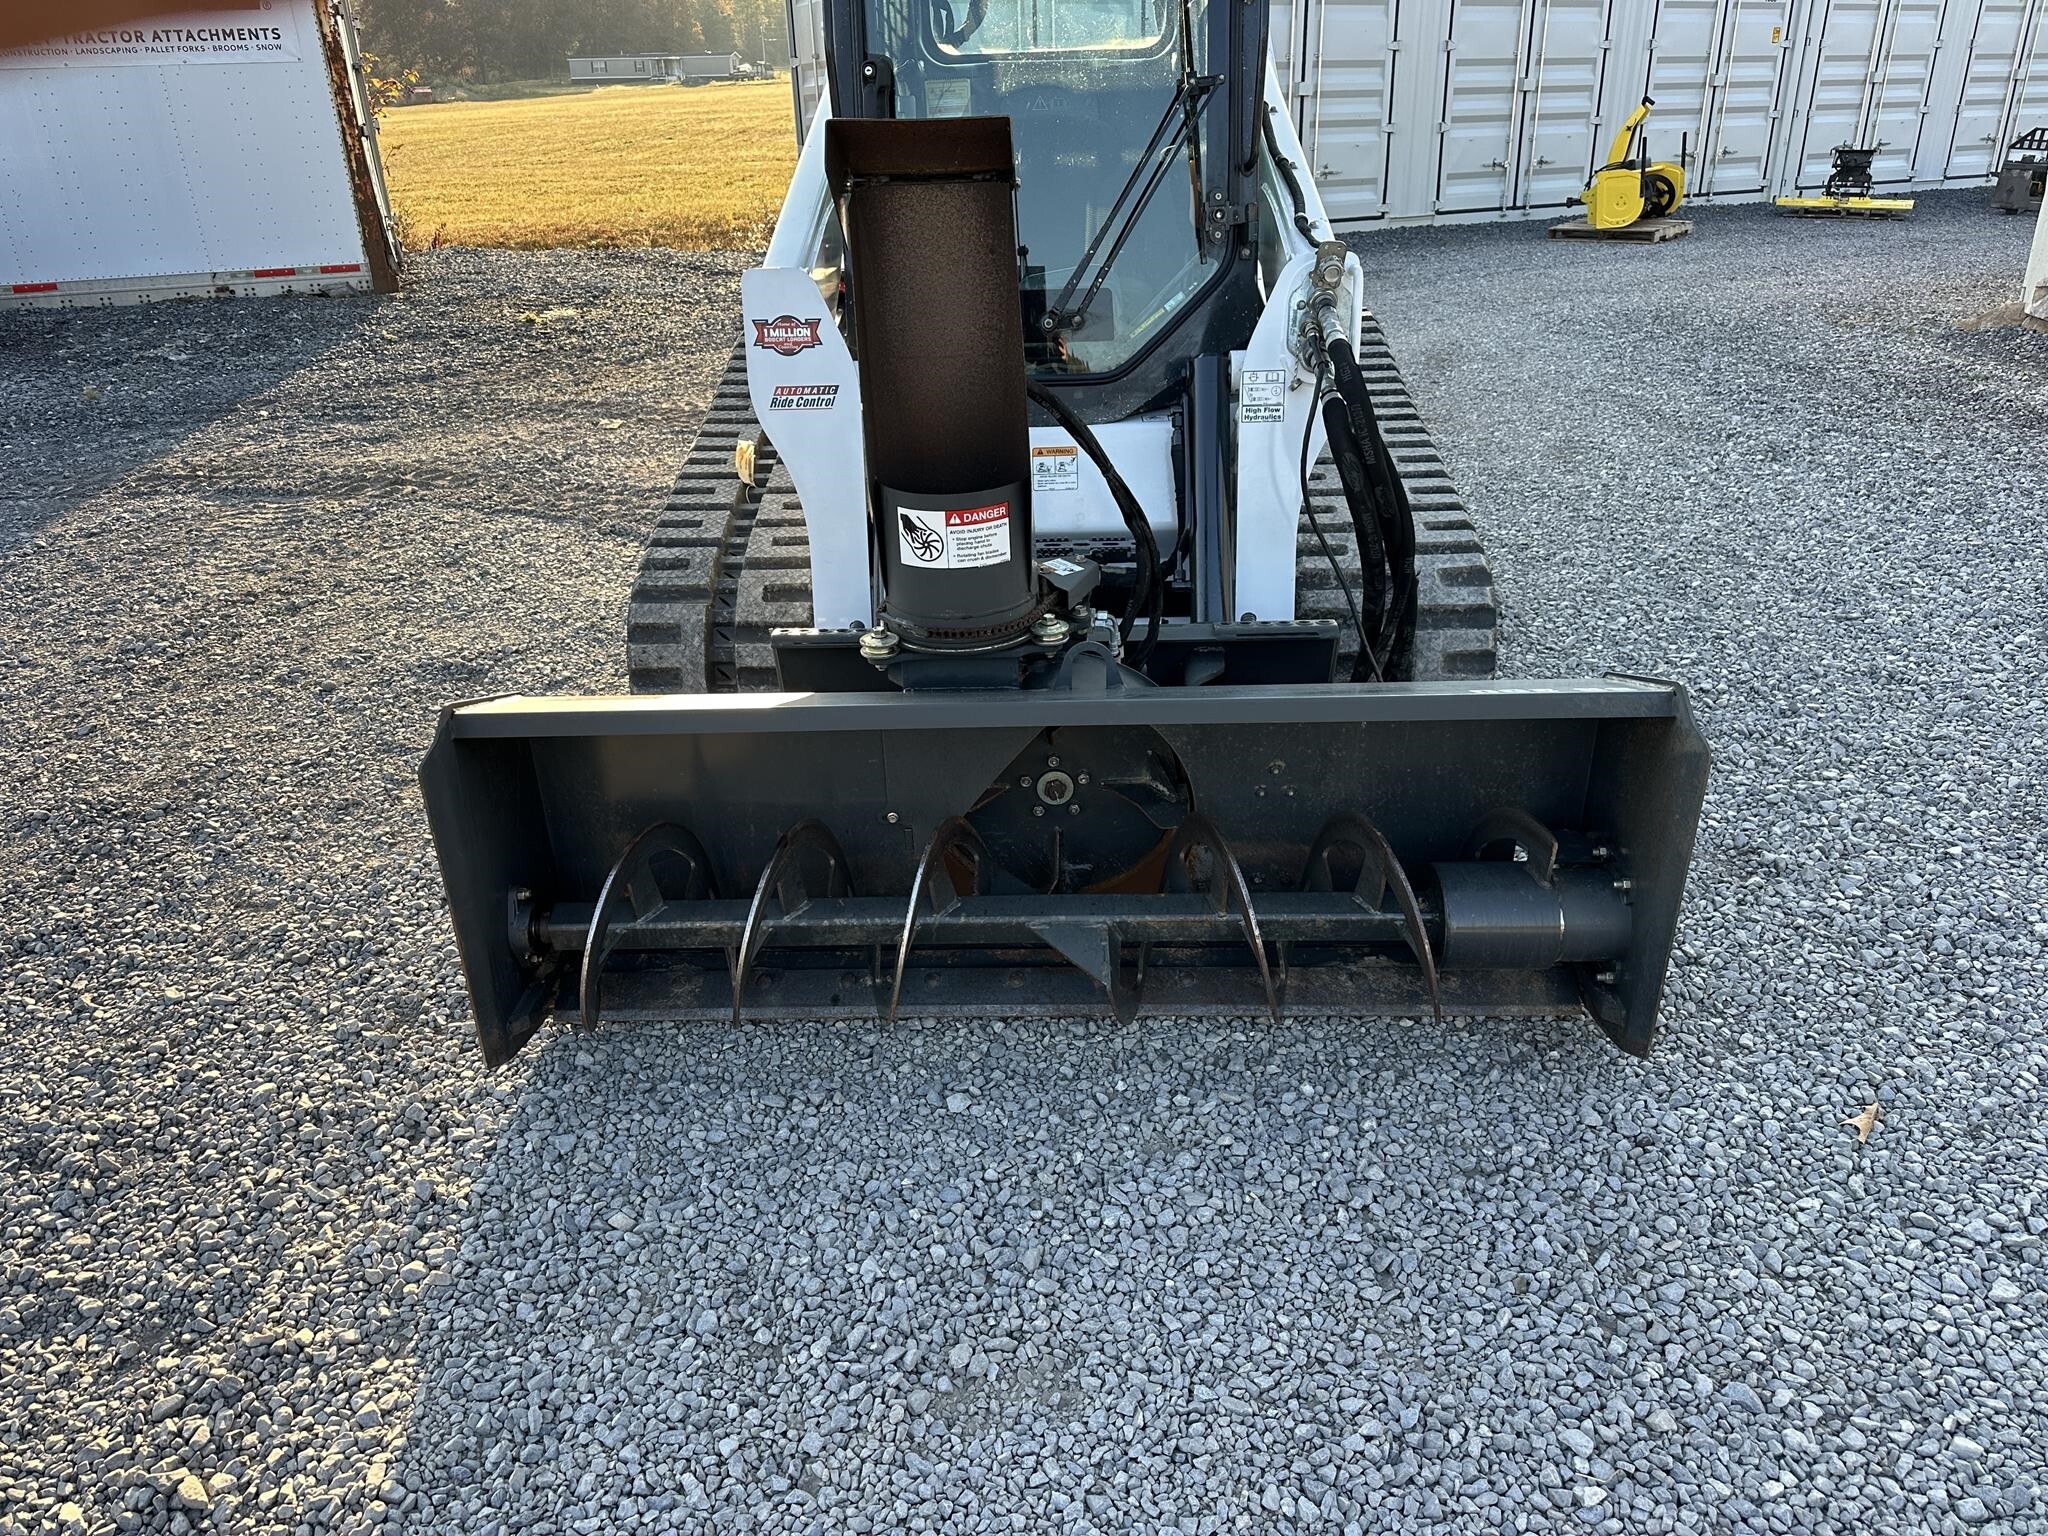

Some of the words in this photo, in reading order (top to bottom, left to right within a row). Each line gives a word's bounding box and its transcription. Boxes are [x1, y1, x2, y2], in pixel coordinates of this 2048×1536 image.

[62, 30, 145, 44] TRACTOR
[152, 28, 281, 43] ATTACHMENTS
[75, 46, 138, 55] LANDSCAPING
[177, 45, 206, 53] FORKS
[212, 44, 249, 52] BROOMS
[255, 43, 282, 51] SNOW
[763, 328, 768, 337] 1
[770, 328, 811, 337] MILLION
[775, 386, 836, 395] AUTOMATIC
[770, 396, 794, 408] Ride
[795, 395, 836, 408] Control
[963, 507, 1006, 522] DANGER
